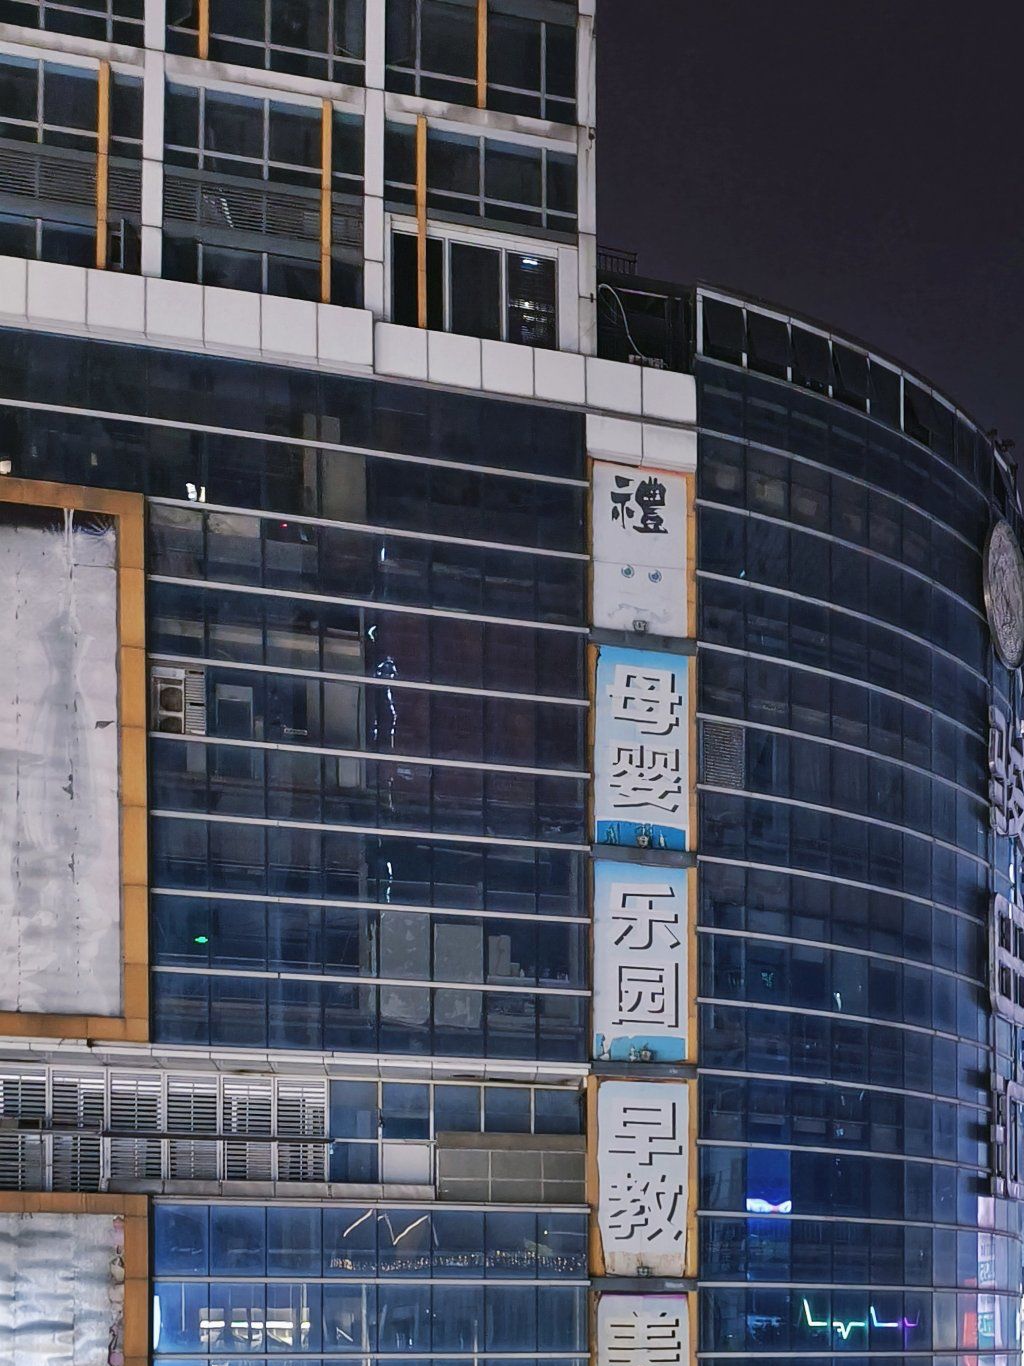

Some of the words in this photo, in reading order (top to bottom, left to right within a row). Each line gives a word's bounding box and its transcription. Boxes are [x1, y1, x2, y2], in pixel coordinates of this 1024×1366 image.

[609, 474, 670, 536] 禮
[607, 664, 683, 814] 母婴
[610, 881, 681, 1030] 乐园
[607, 1100, 683, 1243] 早教
